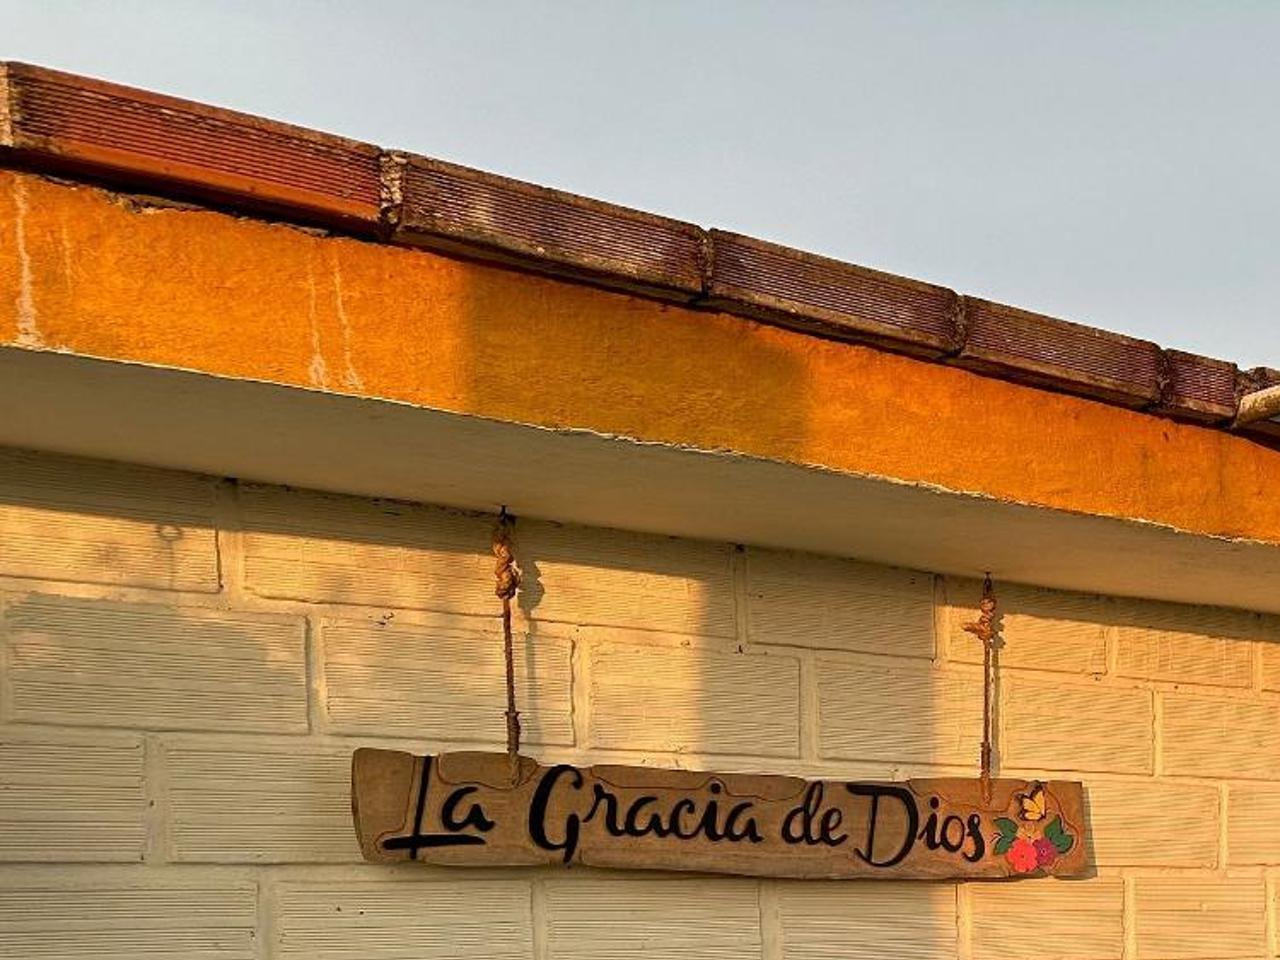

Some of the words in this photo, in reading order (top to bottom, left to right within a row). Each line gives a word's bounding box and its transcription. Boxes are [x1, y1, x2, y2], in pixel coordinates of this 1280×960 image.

[383, 755, 495, 859] La
[529, 764, 763, 863] Gracia
[781, 780, 849, 847] de
[847, 782, 985, 867] Dios
